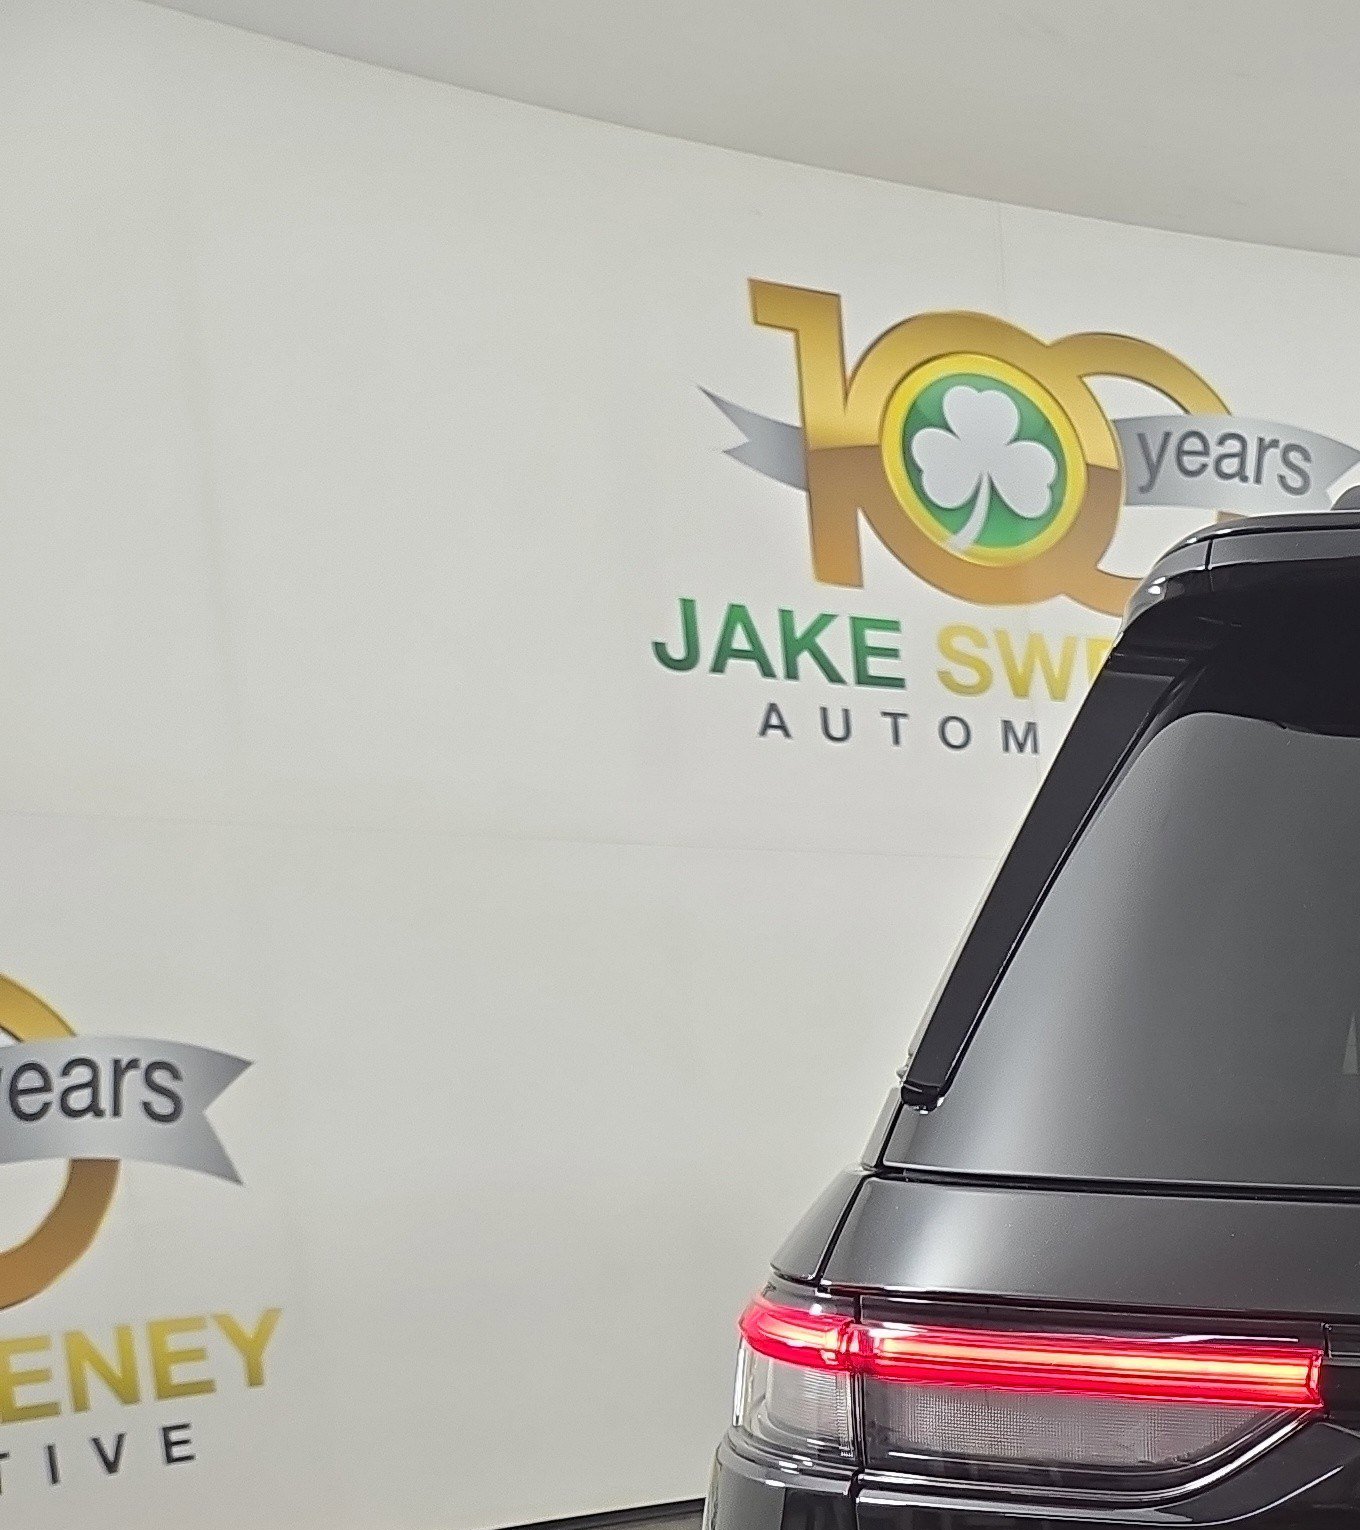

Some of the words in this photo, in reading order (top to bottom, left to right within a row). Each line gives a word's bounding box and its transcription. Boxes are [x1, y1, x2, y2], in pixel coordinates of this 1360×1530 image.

[1137, 431, 1312, 497] years
[652, 597, 908, 690] JAKE
[758, 702, 1040, 756] AUTOM
[0, 1055, 184, 1124] ears
[0, 1422, 195, 1496] IVE
